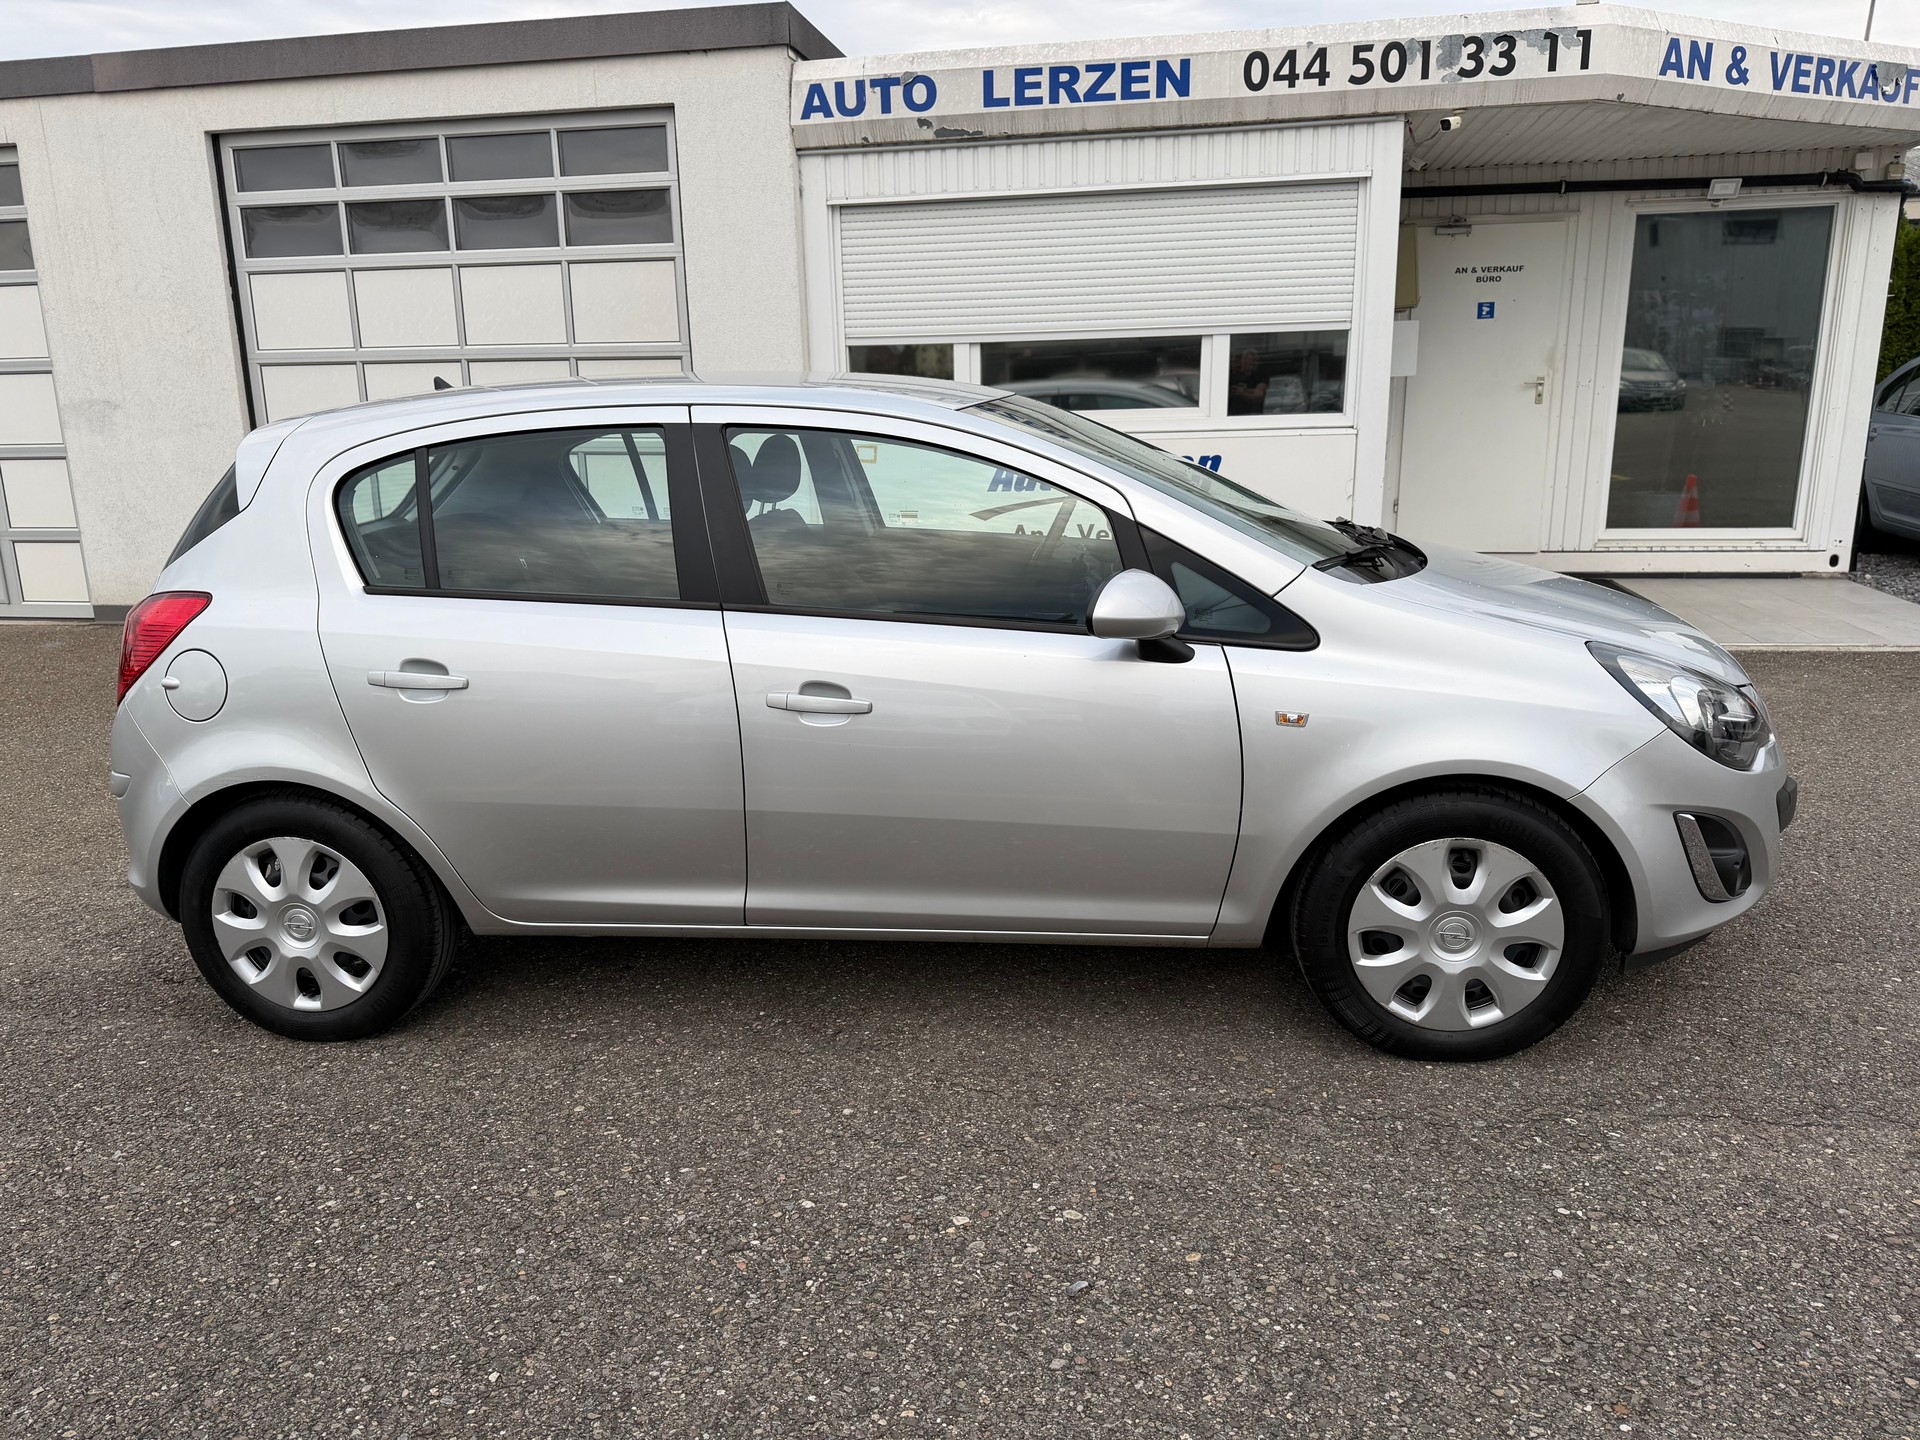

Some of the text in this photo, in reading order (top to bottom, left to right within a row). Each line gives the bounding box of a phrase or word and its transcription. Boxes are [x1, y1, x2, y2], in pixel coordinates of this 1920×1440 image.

[1243, 29, 1593, 92] 044 501 33 11
[1658, 37, 1714, 81] AN
[1725, 45, 1750, 86] &
[800, 58, 1191, 120] AUTO LERZEN
[1475, 275, 1502, 283] BÜRO
[1481, 265, 1524, 273] VERKAUF
